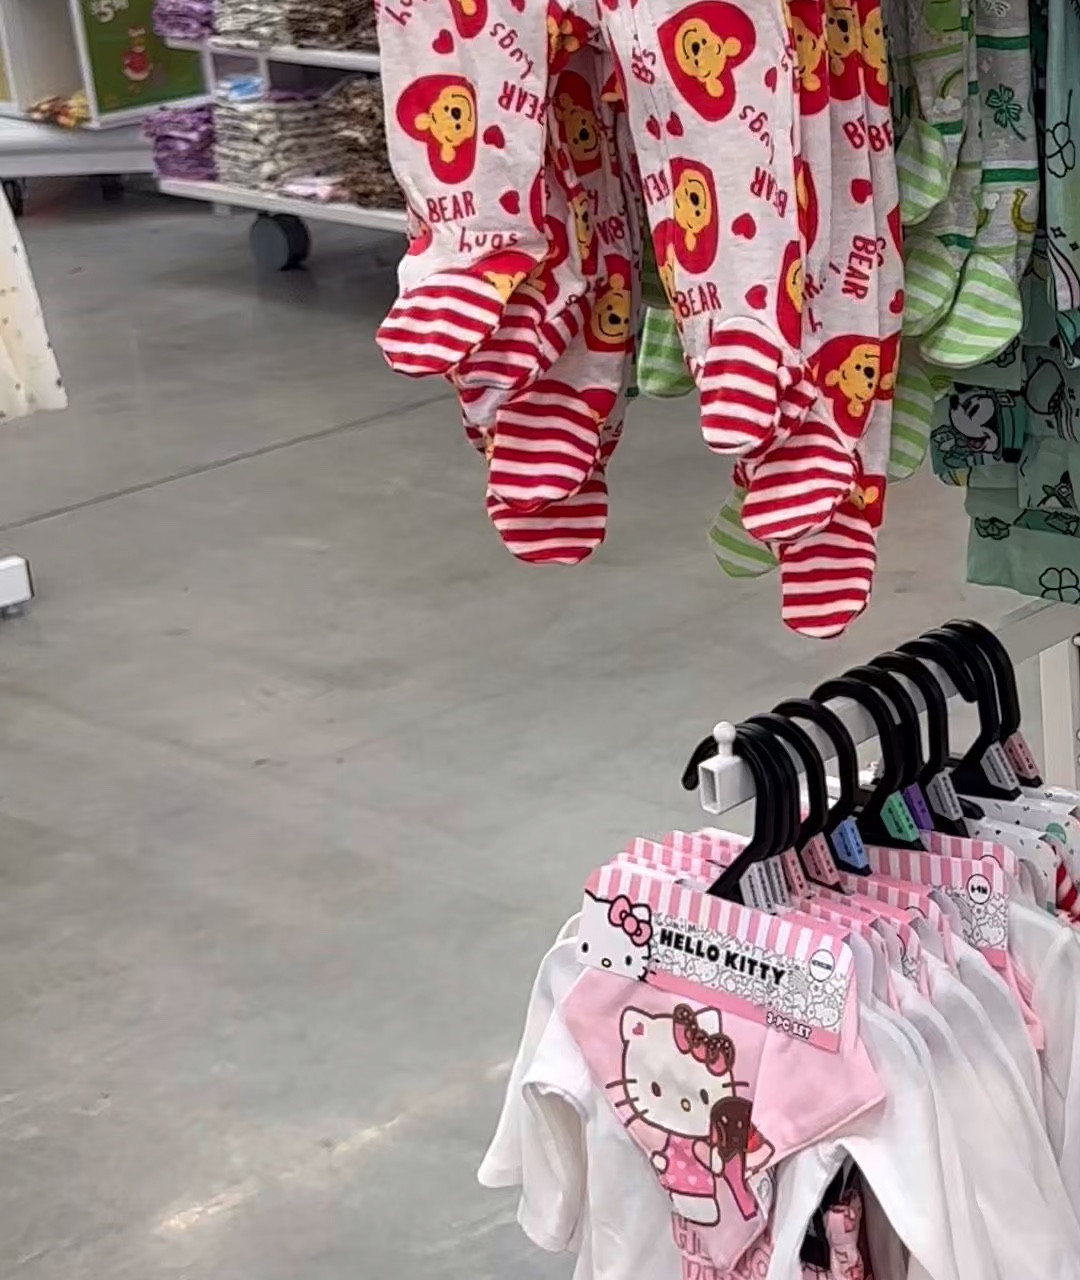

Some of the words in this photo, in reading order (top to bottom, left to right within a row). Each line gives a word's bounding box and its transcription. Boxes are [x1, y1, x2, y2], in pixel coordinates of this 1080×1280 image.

[489, 21, 536, 81] hugs
[425, 190, 477, 223] BEAR
[459, 227, 519, 253] hugs
[676, 280, 722, 319] BEAR
[660, 929, 720, 962] HELLO
[724, 951, 786, 986] KITTY
